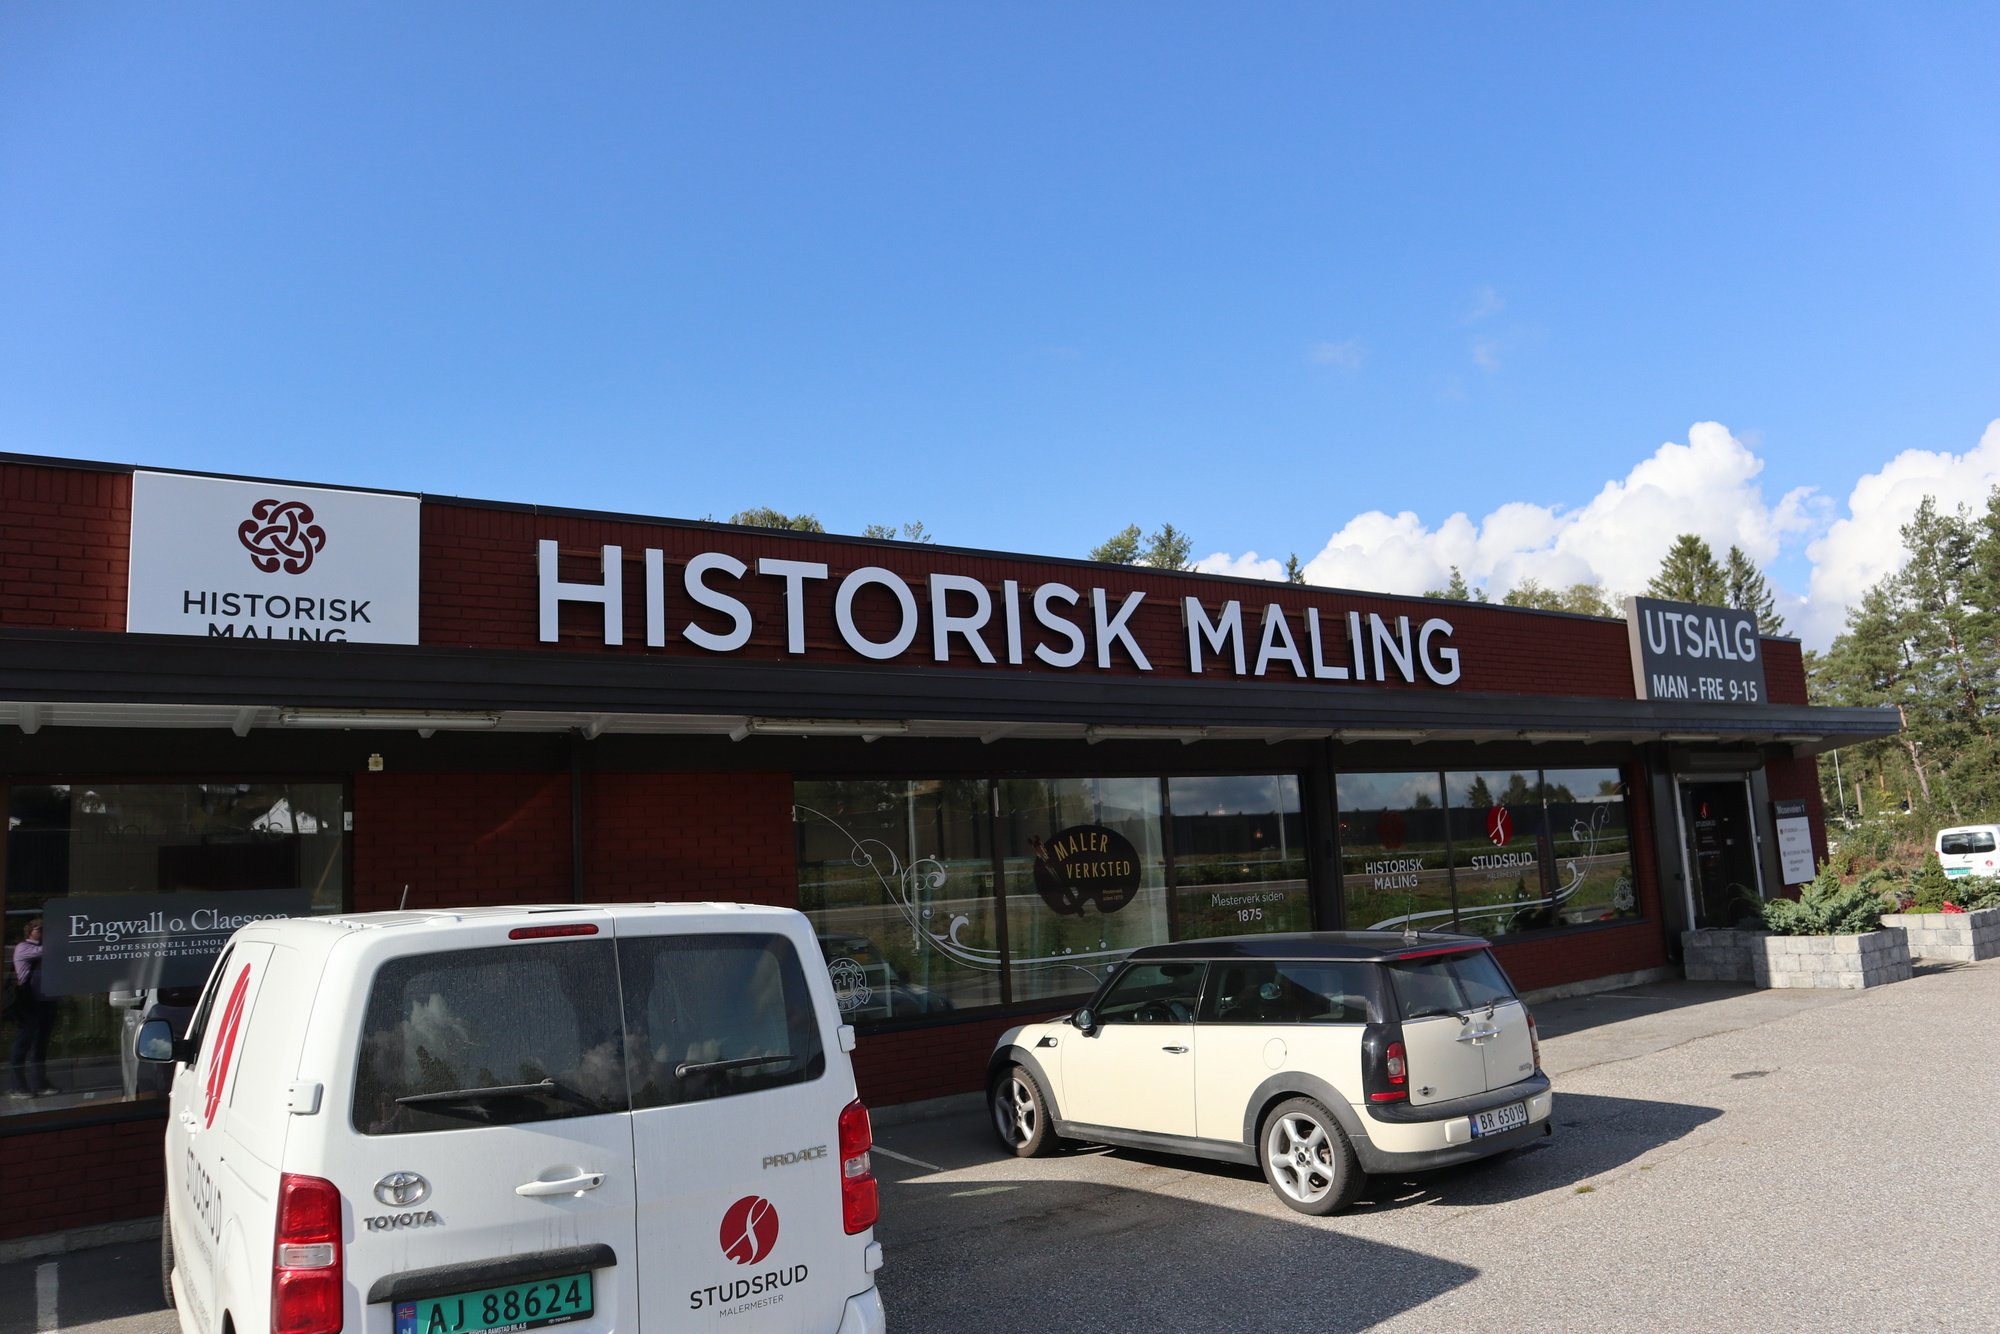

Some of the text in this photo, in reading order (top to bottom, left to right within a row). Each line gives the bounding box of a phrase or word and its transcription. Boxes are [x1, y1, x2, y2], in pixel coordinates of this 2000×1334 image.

[184, 590, 371, 623] HISTORISK
[538, 539, 1461, 686] HISTORISK MALING
[1645, 609, 1756, 662] UTSALG
[1653, 674, 1689, 699] MAN
[1699, 677, 1725, 700] FRE
[1729, 679, 1758, 702] 9-15
[1053, 832, 1108, 861] MALER
[1066, 861, 1130, 879] VERKSTED
[1365, 858, 1424, 875] HISTORISK
[1471, 852, 1533, 870] STUDSRUD
[1374, 874, 1418, 890] MALING
[1486, 870, 1521, 880] MALERMESTER
[1211, 891, 1284, 907] Mesterverk siden
[68, 911, 165, 943] Engwall
[169, 918, 187, 932] o.
[1237, 908, 1263, 922] 1875
[87, 951, 150, 961] TRADITION
[98, 941, 188, 952] PROFESSIONELL
[1480, 1113, 1495, 1130] BR
[1498, 1104, 1525, 1125] 65019
[763, 1145, 828, 1169] PROACE
[186, 1146, 222, 1246] STUDSRUD
[364, 1210, 437, 1231] TOYOTA
[690, 1264, 808, 1310] STUDSRUD
[427, 1299, 465, 1334] AJ
[482, 1280, 582, 1325] 88624
[719, 1294, 784, 1318] MALERMESTER
